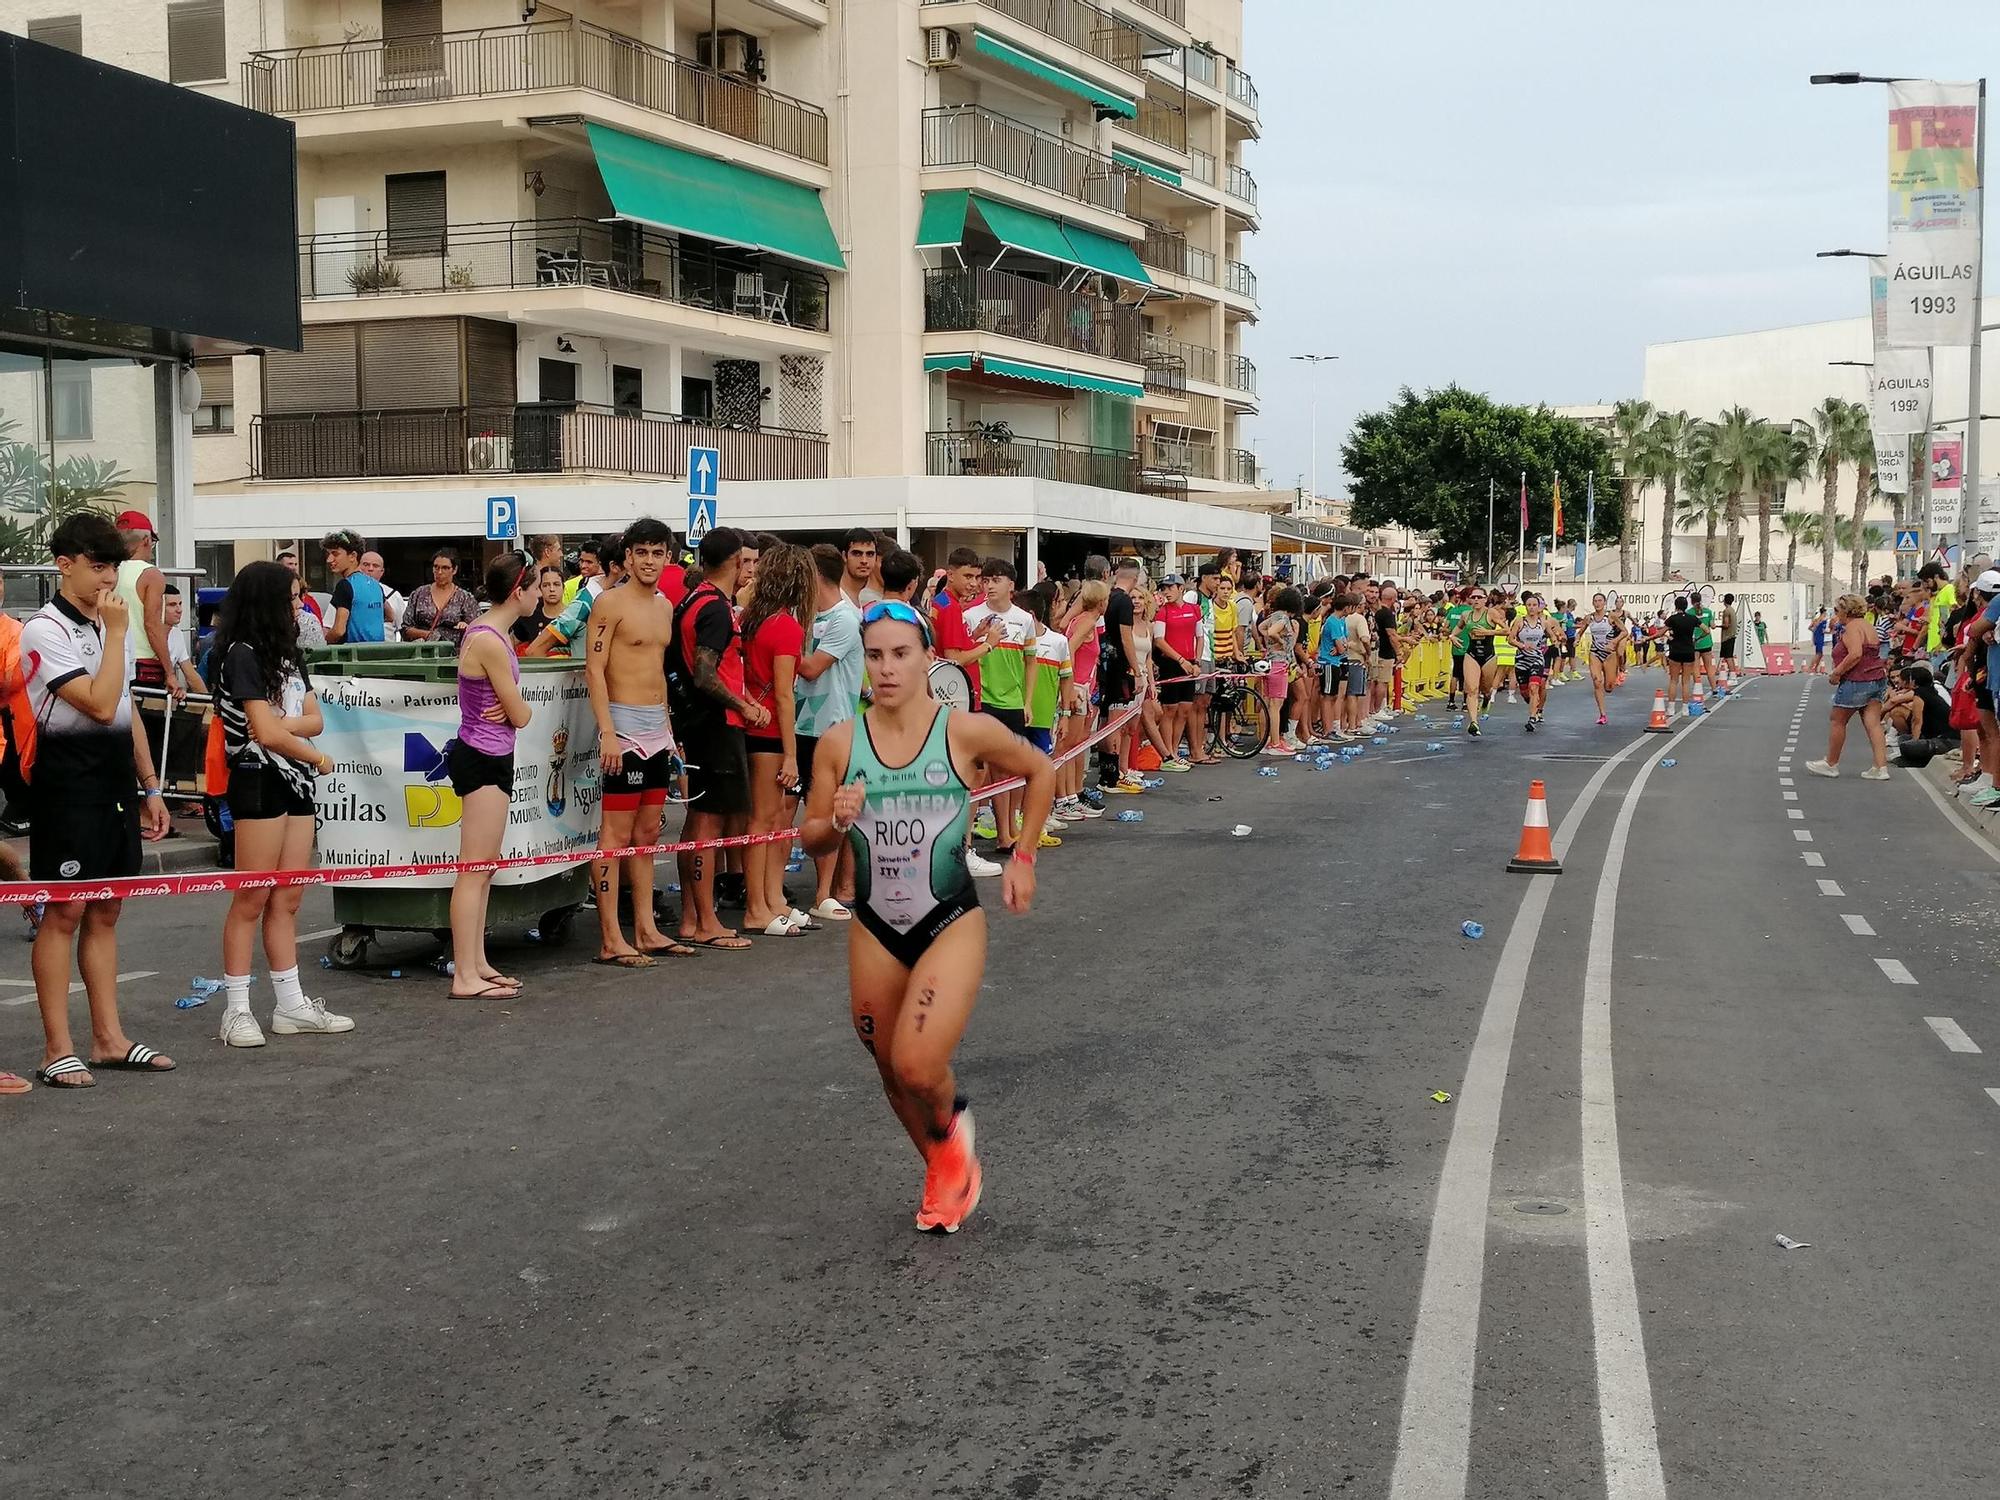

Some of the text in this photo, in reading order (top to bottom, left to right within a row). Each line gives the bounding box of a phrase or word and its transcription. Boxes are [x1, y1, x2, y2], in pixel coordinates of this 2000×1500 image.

[1893, 262, 1973, 281] ÁGUILAS
[1910, 296, 1956, 314] 1993
[1877, 377, 1930, 390] ÁGUILAS
[1890, 400, 1919, 412] 1992
[492, 501, 512, 535] P
[1933, 516, 1953, 524] 1990
[322, 688, 334, 704] de
[337, 686, 381, 711] Águilas
[521, 686, 555, 706] Municipal
[332, 760, 383, 777] miento
[327, 778, 346, 794] de
[875, 818, 925, 847] RICO
[325, 849, 390, 868] Municipal
[411, 850, 460, 866] Ayunta
